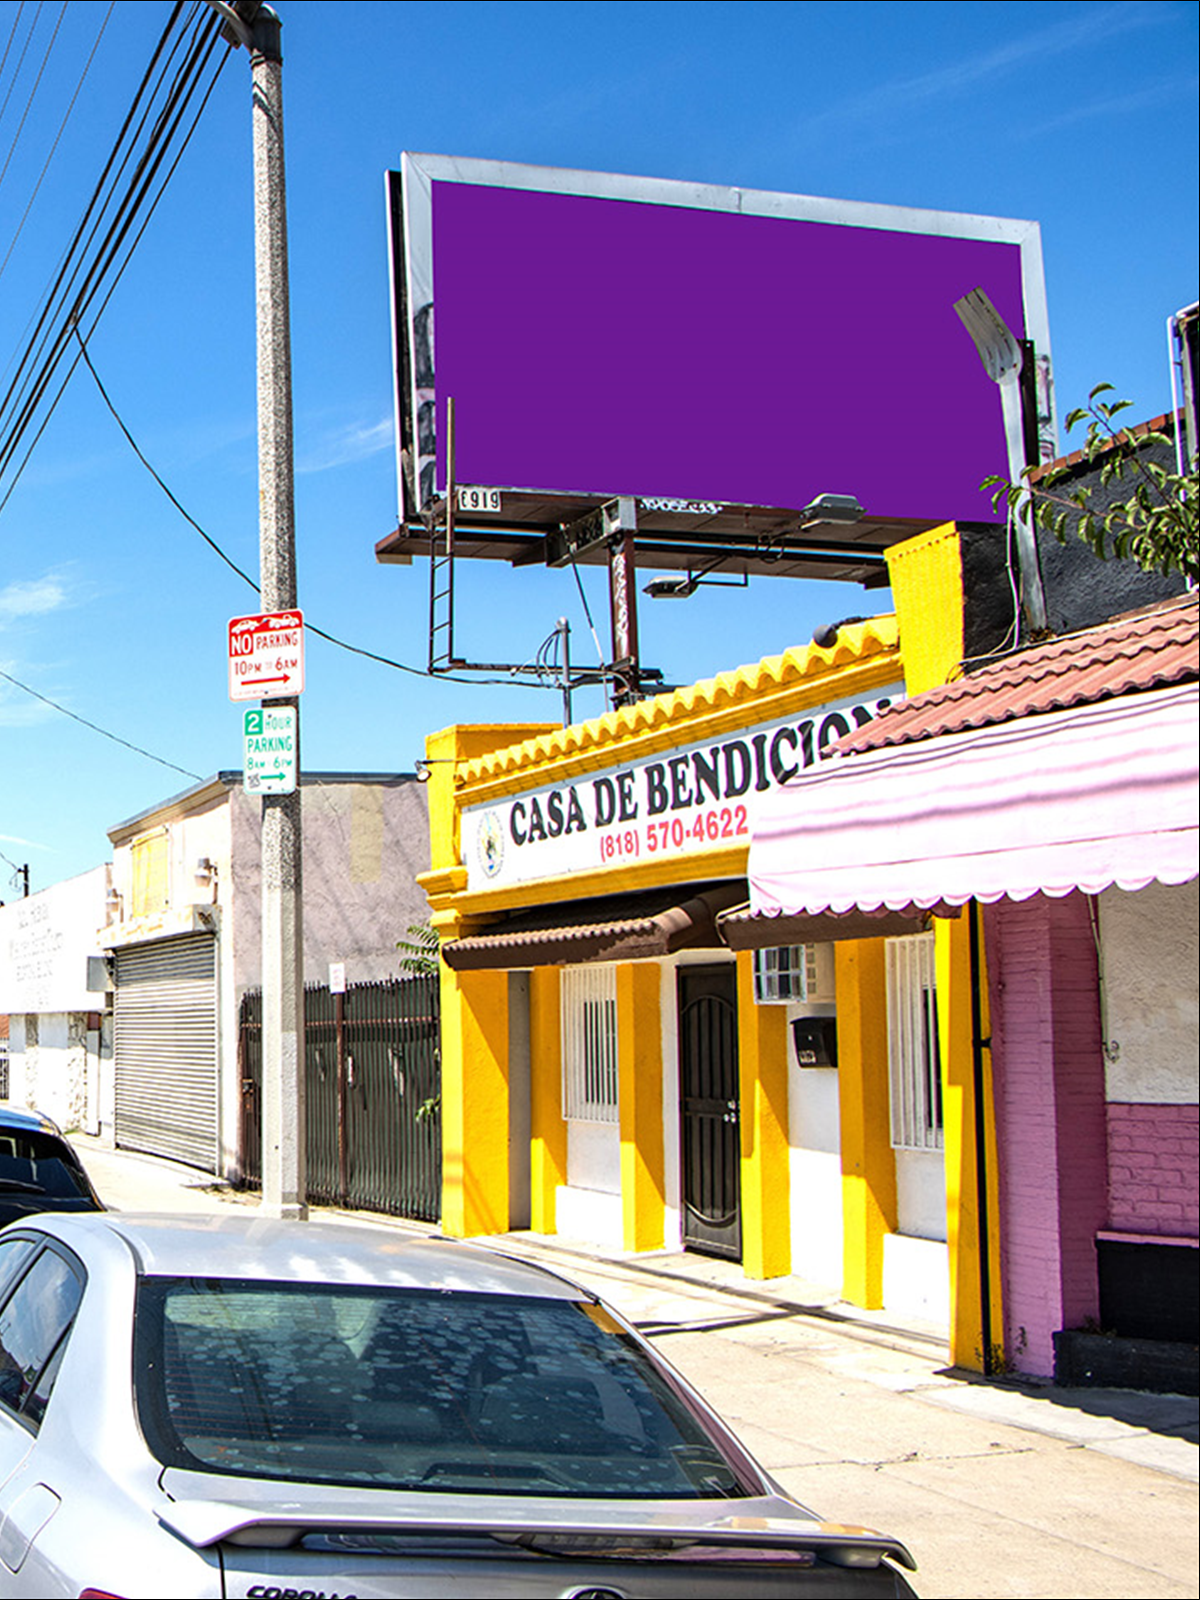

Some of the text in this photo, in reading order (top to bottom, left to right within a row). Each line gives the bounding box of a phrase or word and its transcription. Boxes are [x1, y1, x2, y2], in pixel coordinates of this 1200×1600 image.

[231, 631, 298, 655] NO PARKING
[235, 660, 262, 676] 10PM
[275, 656, 298, 671] 6AM
[247, 713, 292, 732] 2 HOUR
[247, 735, 293, 753] PARKING
[247, 757, 265, 770] 8AM
[273, 756, 292, 769] 6PM
[509, 785, 587, 846] CASA
[592, 770, 639, 828] DE
[644, 698, 892, 817] BENDICIO
[600, 829, 640, 863] (818)
